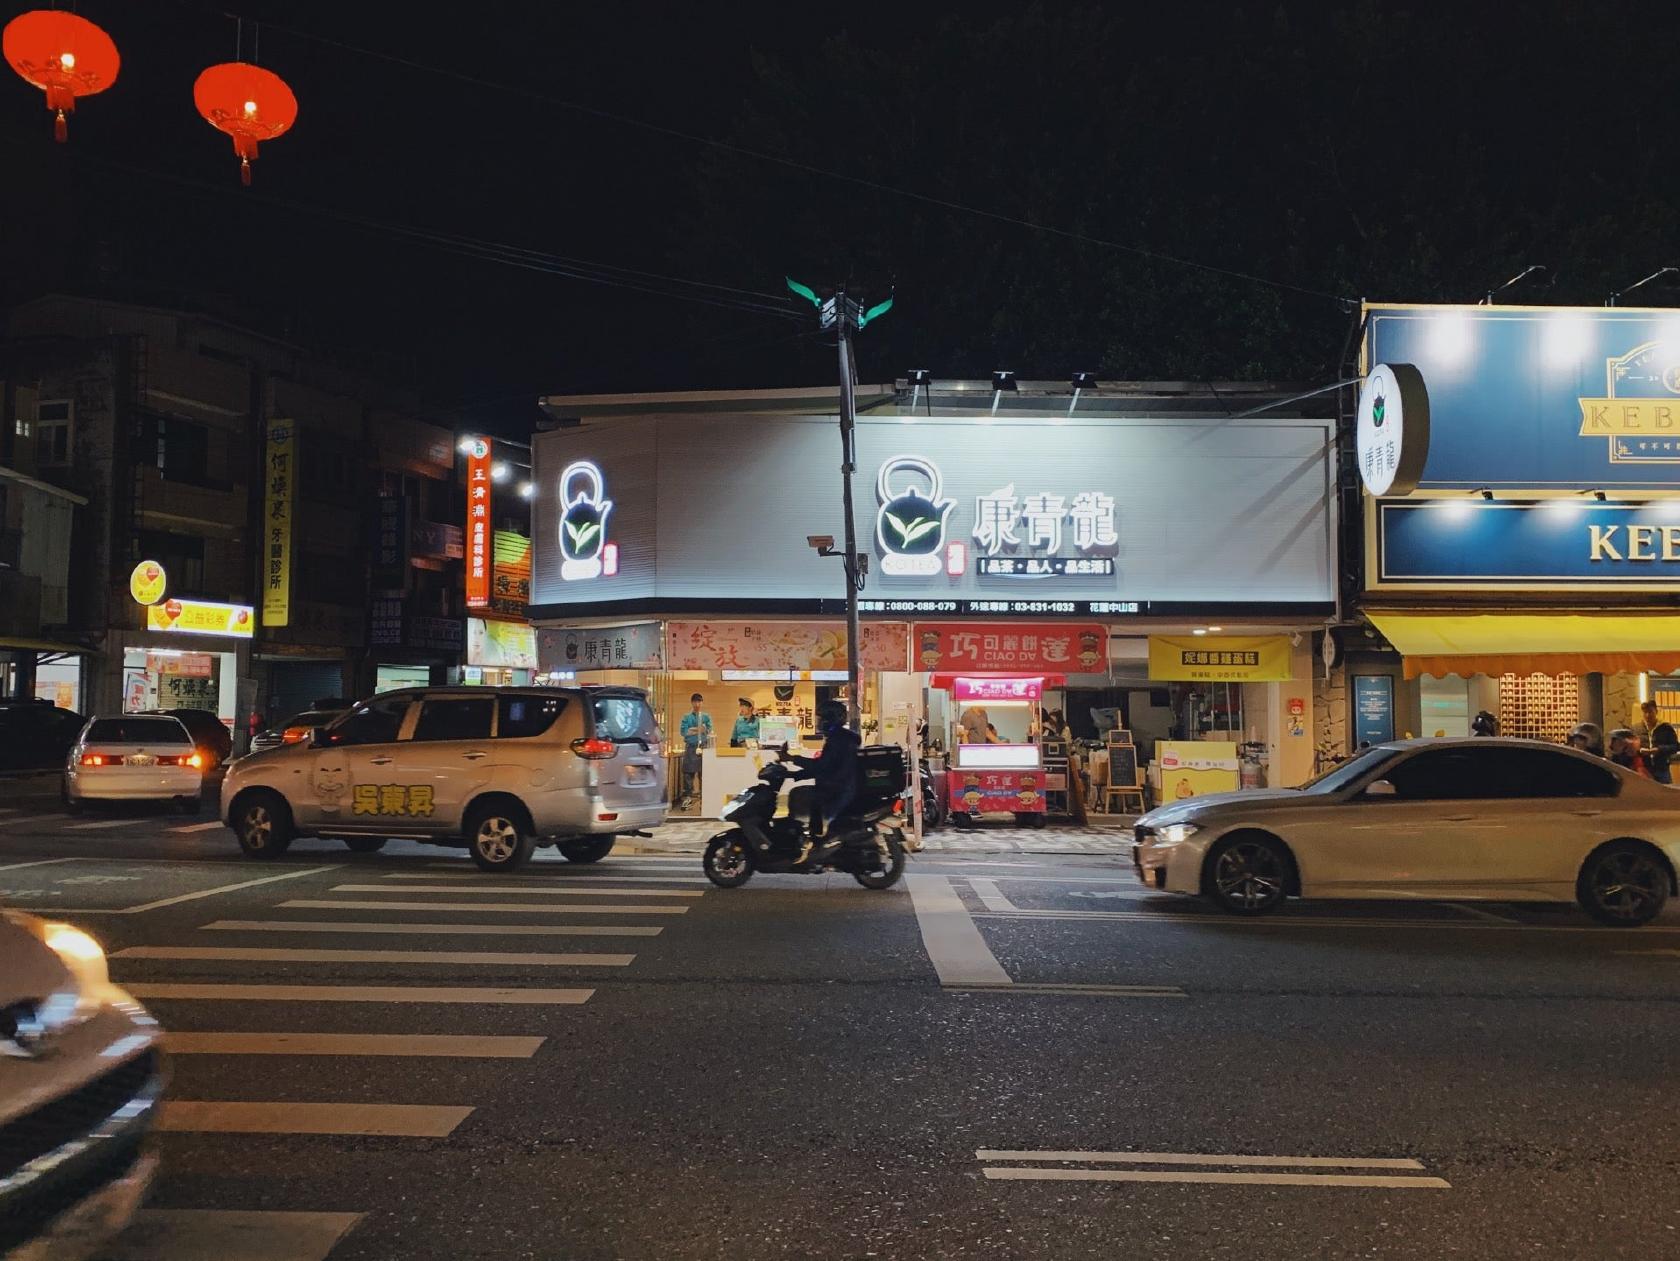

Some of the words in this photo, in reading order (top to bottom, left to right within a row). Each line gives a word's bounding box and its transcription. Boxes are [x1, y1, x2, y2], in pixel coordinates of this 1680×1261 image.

[1590, 406, 1673, 428] KEB
[971, 482, 1118, 556] 康青龍
[584, 638, 629, 663] 康青龍
[983, 652, 1016, 662] CIAO
